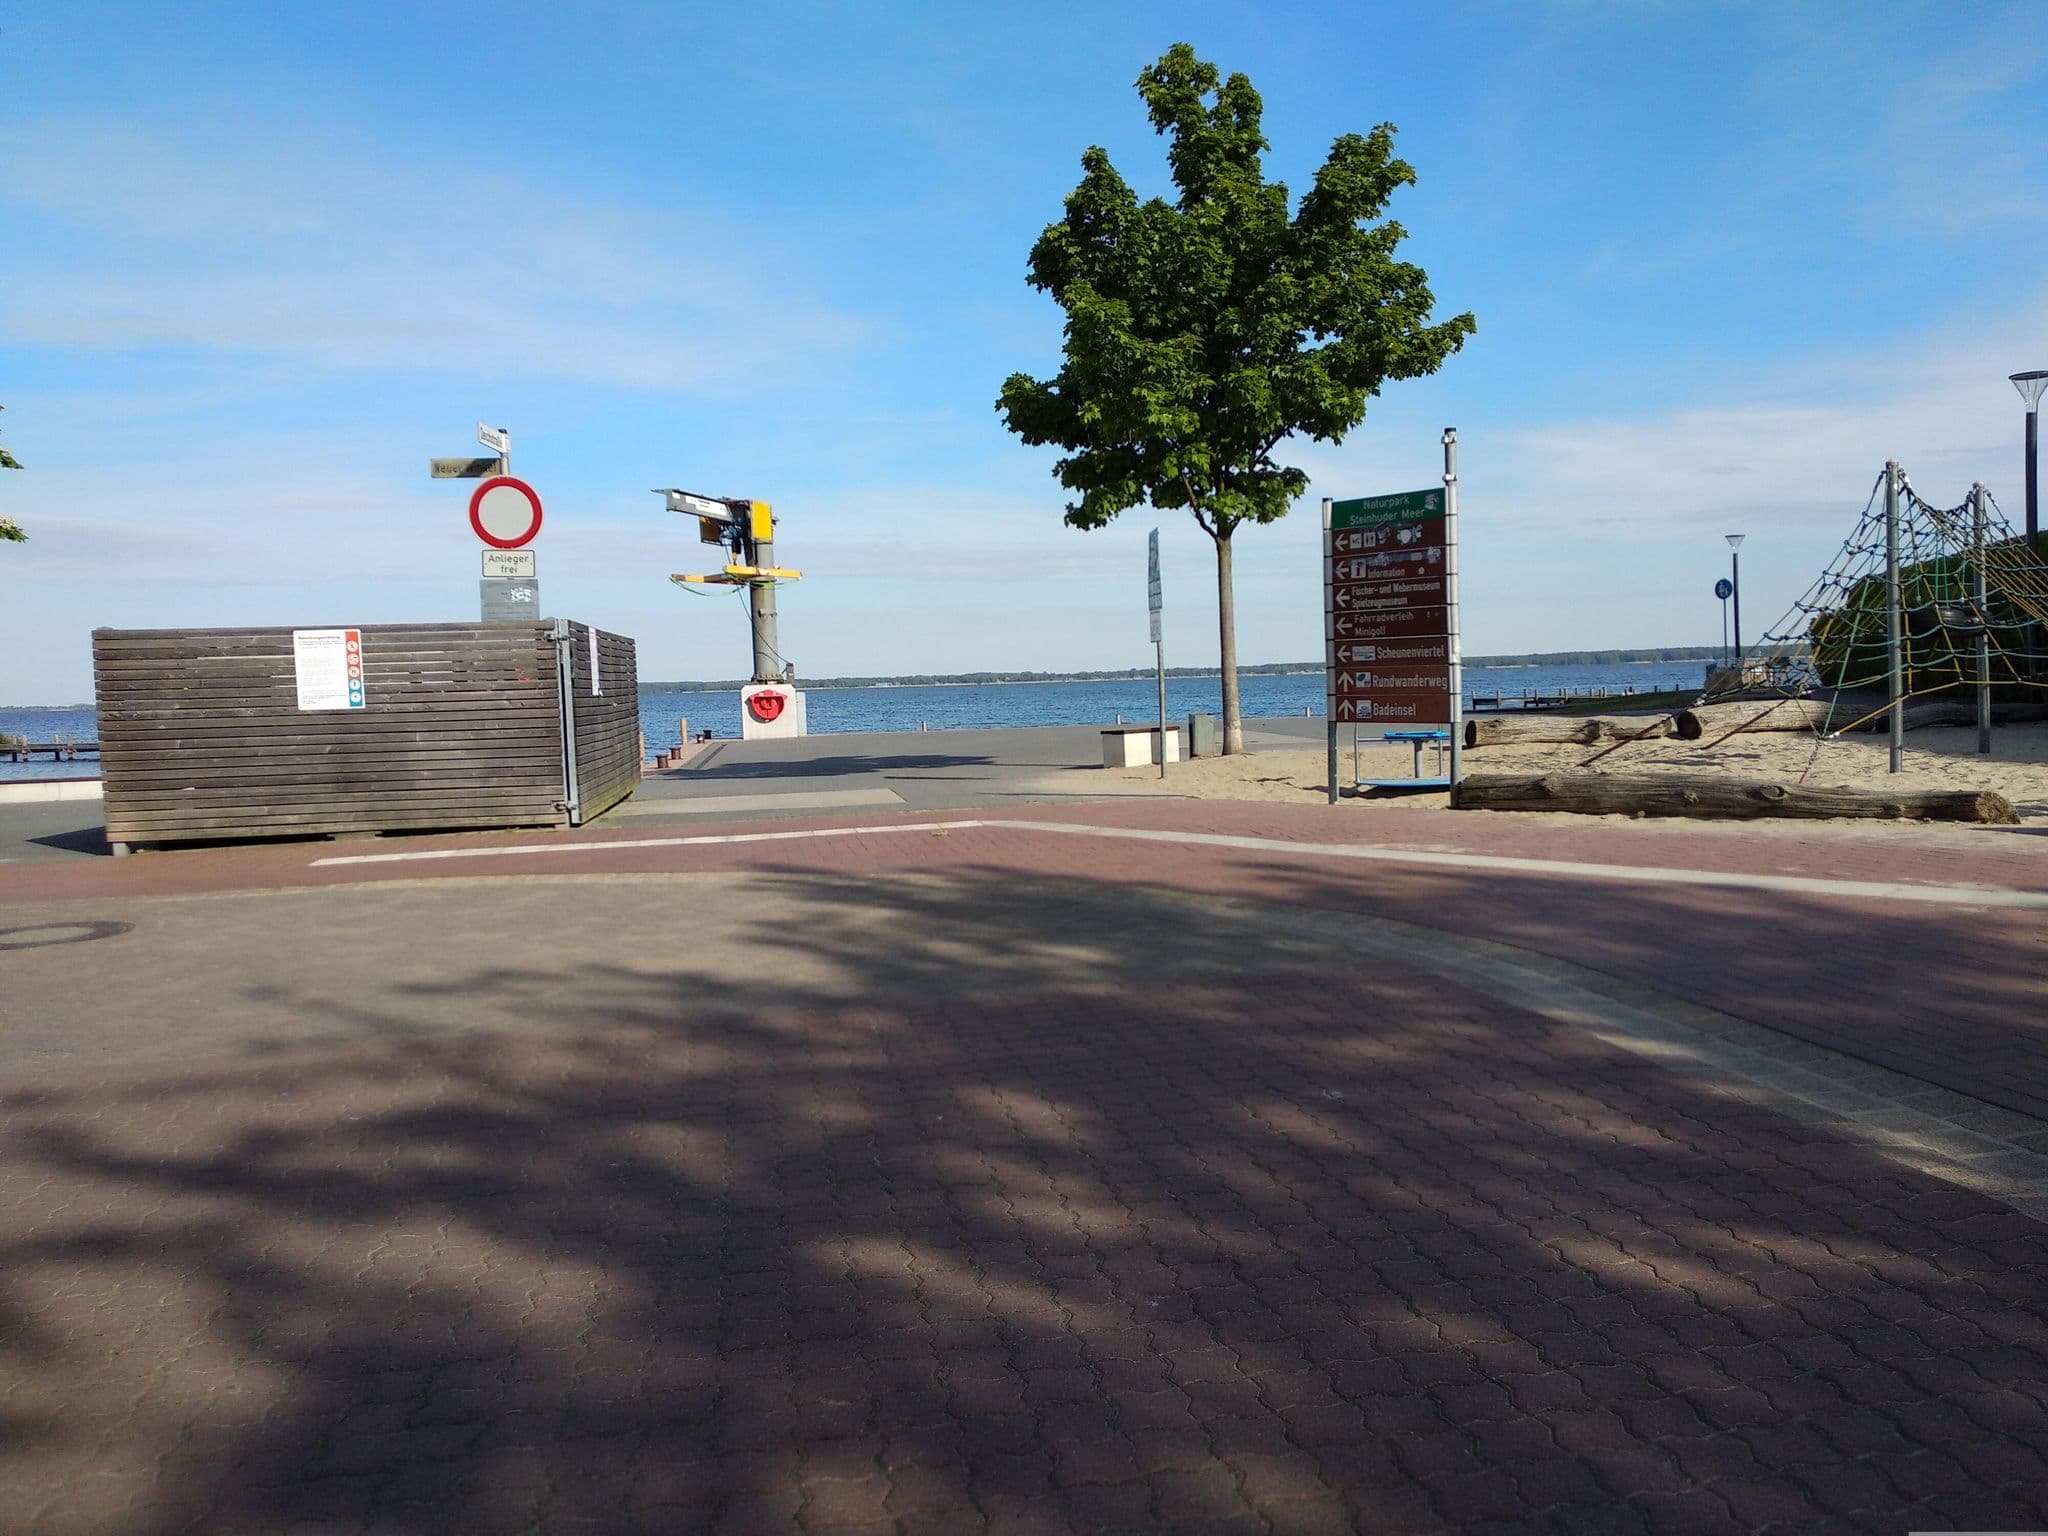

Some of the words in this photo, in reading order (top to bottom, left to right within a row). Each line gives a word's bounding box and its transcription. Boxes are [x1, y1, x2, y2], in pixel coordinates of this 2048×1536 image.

[1363, 496, 1410, 510] Naturpark
[1350, 513, 1397, 525] Steinhuder
[1401, 508, 1425, 519] Meer
[488, 554, 529, 565] Anlieger
[501, 565, 518, 574] frei
[1367, 568, 1405, 579] Information
[1351, 585, 1379, 596] Fischer-
[1380, 583, 1392, 594] und
[1393, 581, 1441, 592] Webermuseum
[1351, 596, 1408, 609] Spielzeugmuseum
[1354, 611, 1415, 624] Fahrradverleih
[1354, 626, 1386, 638] Minigolf
[1376, 645, 1445, 659] Scheunenviertel
[1372, 675, 1448, 689] Rundwanderweg
[1373, 703, 1417, 716] Badeinsel
